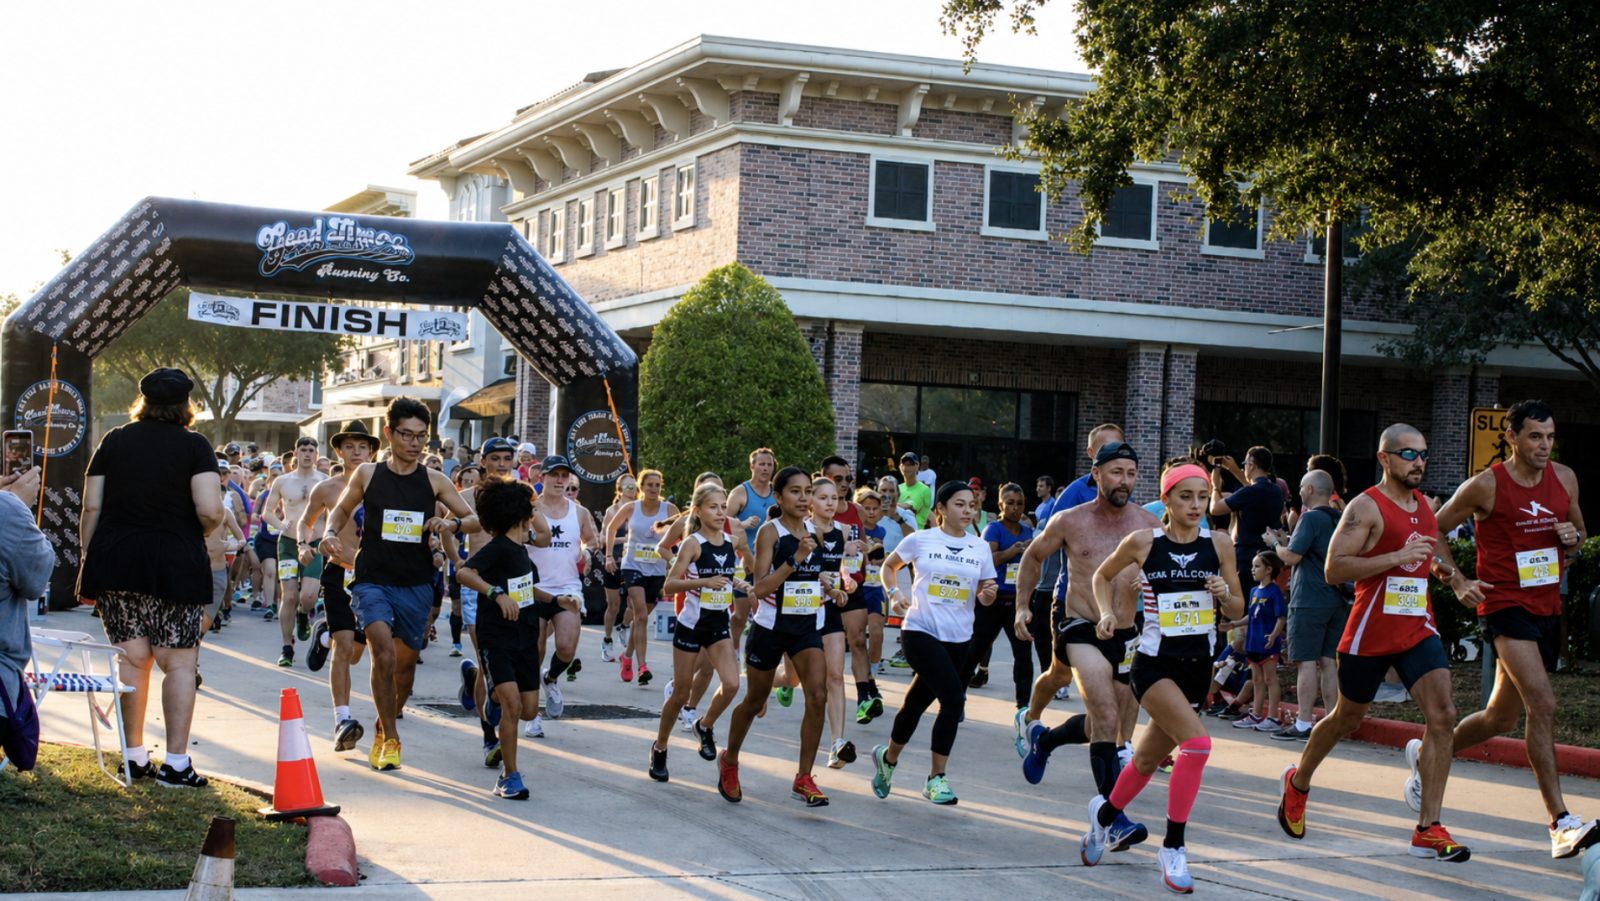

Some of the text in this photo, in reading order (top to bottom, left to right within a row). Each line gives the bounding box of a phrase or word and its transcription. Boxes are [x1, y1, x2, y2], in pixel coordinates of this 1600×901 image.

[251, 301, 408, 337] FINISH
[1477, 415, 1508, 431] SLO
[1173, 610, 1200, 626] 471
